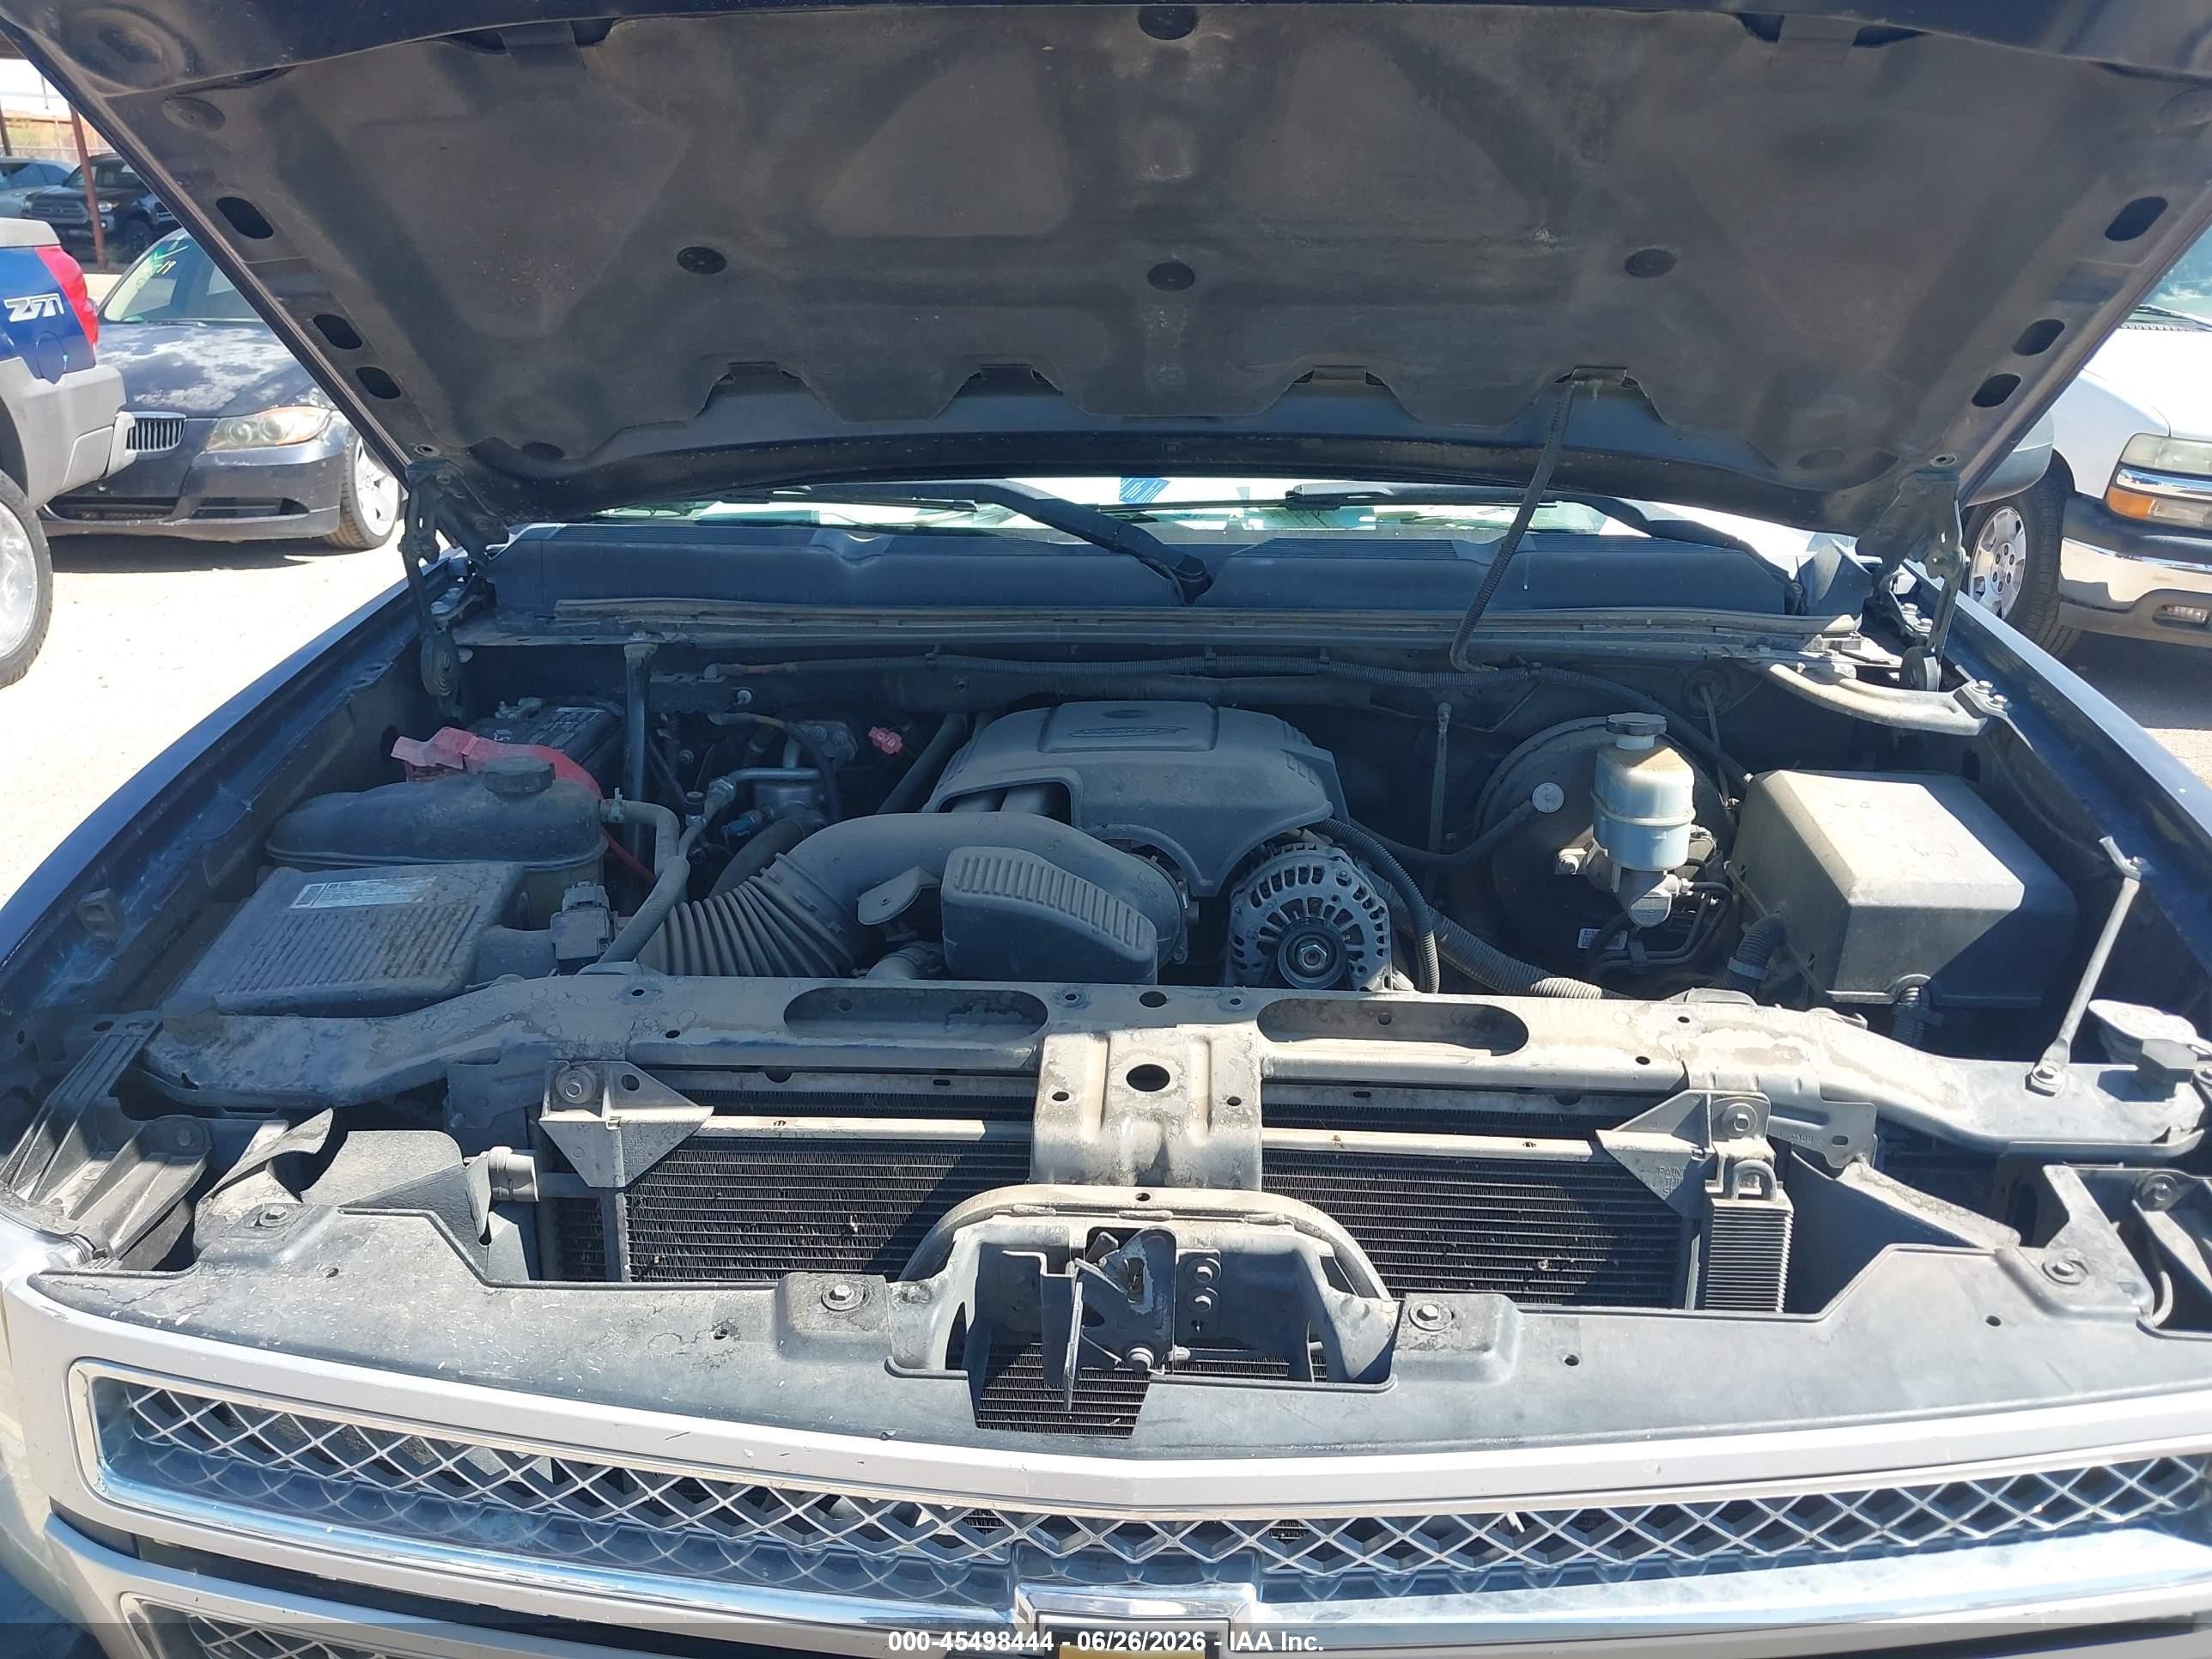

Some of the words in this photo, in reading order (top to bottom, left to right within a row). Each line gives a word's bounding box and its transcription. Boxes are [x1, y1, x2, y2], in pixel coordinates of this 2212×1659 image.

[3, 292, 65, 323] Z71
[623, 1147, 647, 1157] THIS
[624, 1157, 645, 1166] SIDE
[1665, 1176, 1682, 1187] THI
